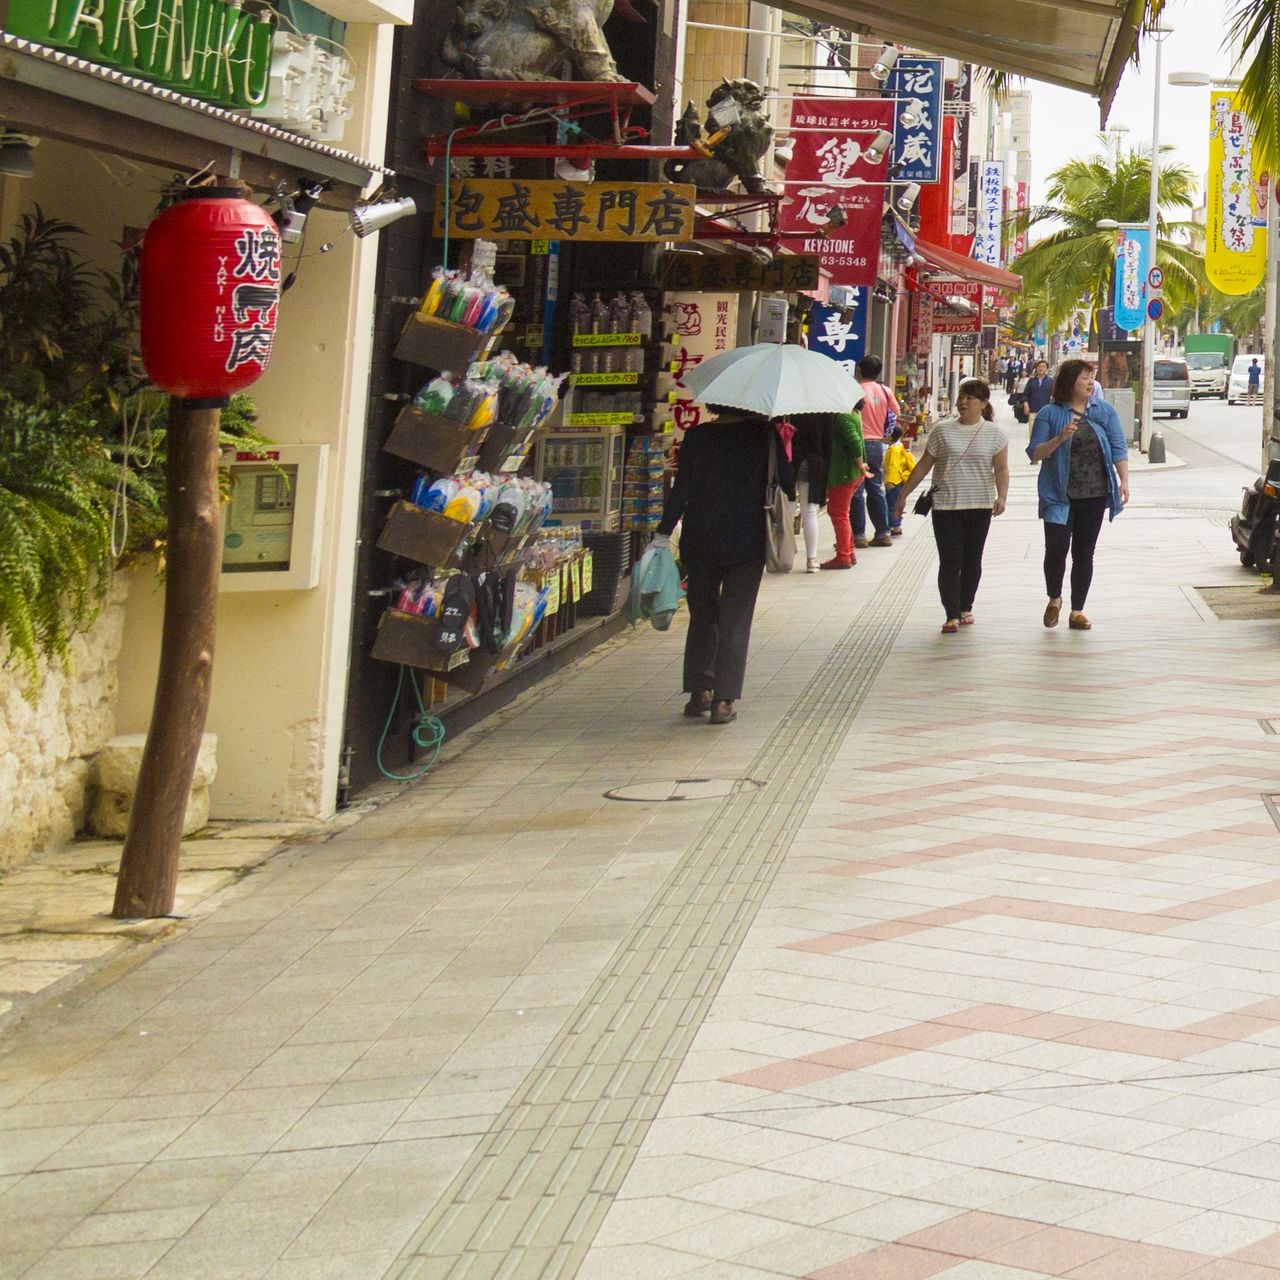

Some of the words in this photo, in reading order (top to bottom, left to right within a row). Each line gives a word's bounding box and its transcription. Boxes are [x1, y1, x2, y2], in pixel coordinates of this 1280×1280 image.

[795, 114, 889, 128] 琉球民芸ギャラリー
[440, 182, 691, 237] 泡盛専門店
[804, 238, 855, 254] KEYSTONE
[217, 256, 228, 296] YAKI
[212, 305, 226, 342] NIKU
[714, 300, 729, 351] 観光民芸
